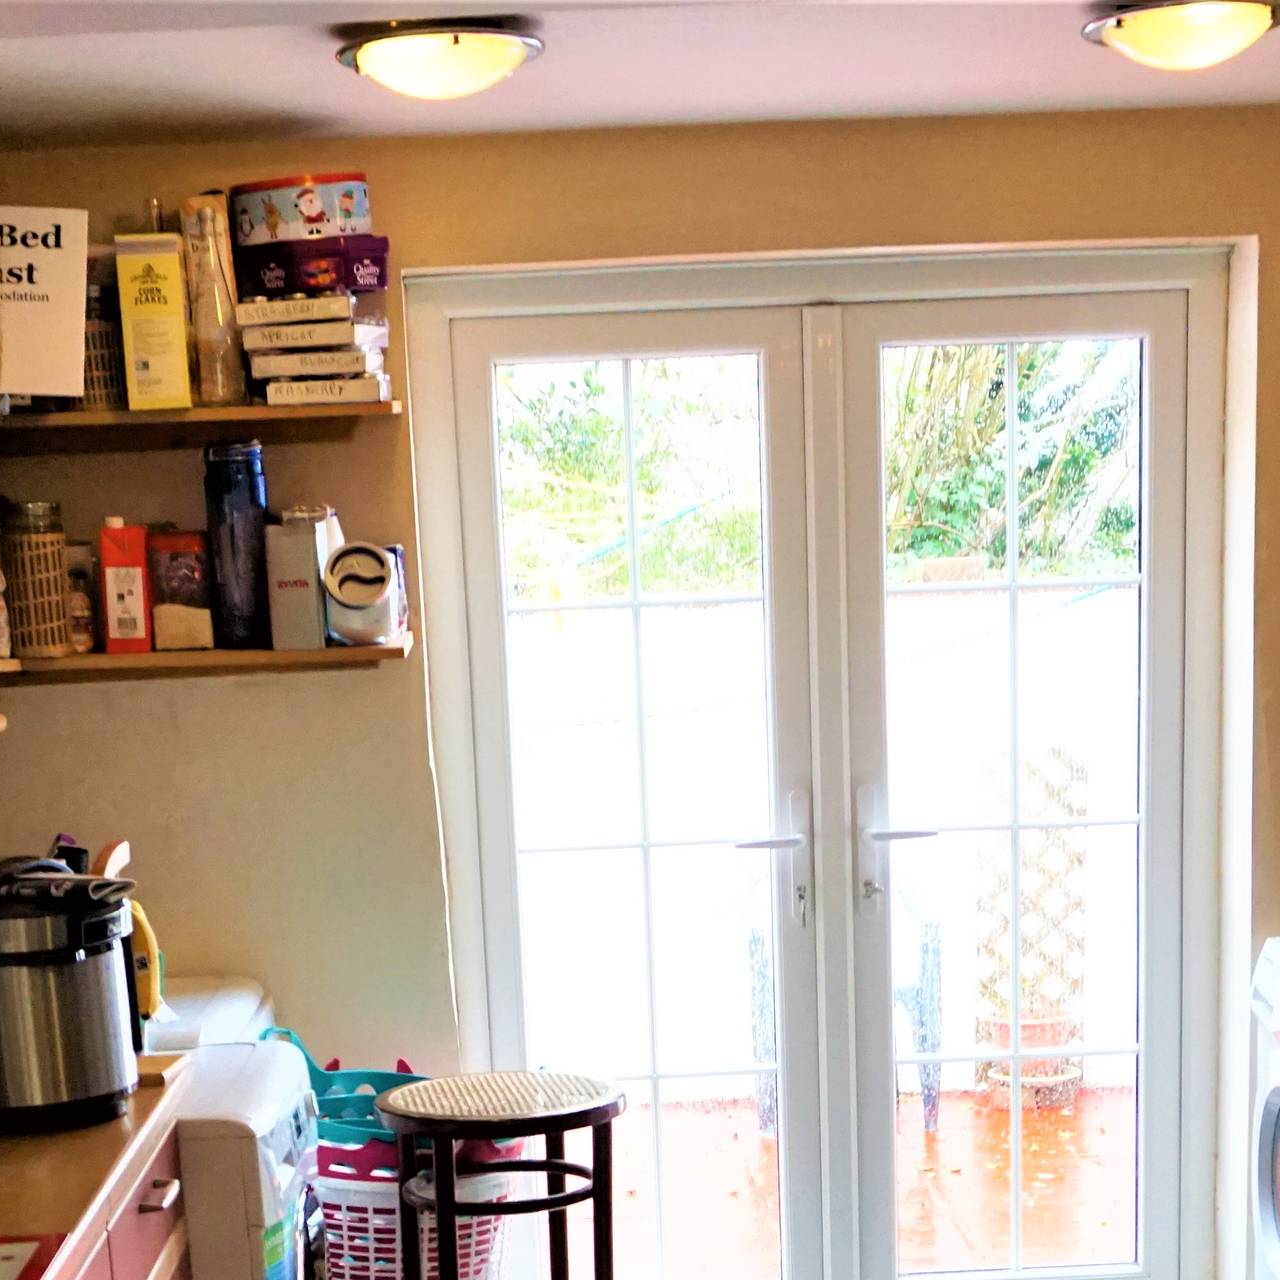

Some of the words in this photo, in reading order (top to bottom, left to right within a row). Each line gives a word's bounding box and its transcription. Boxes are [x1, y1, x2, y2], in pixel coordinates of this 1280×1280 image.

[353, 262, 380, 277] Quality
[356, 275, 378, 286] Street
[138, 287, 162, 297] CORN
[134, 296, 168, 306] FLAKES
